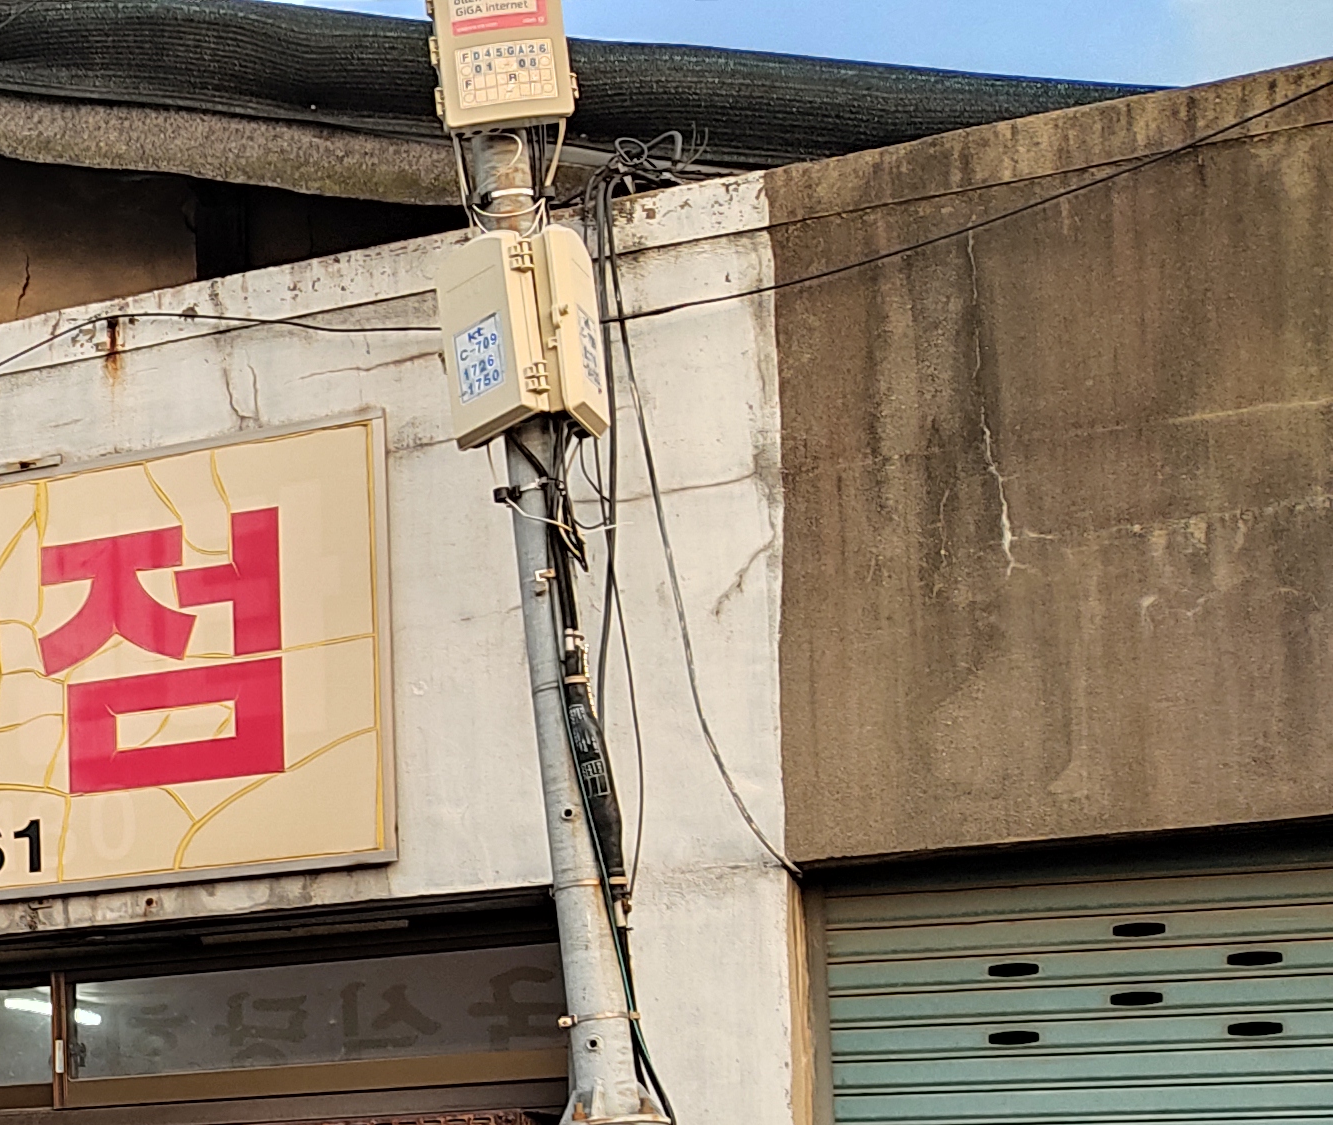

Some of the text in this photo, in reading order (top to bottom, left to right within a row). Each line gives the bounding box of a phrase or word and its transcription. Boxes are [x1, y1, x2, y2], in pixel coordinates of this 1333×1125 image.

[455, 4, 483, 17] GiGA
[485, 0, 529, 13] internet
[460, 333, 497, 361] C-709
[464, 354, 495, 381] 1726
